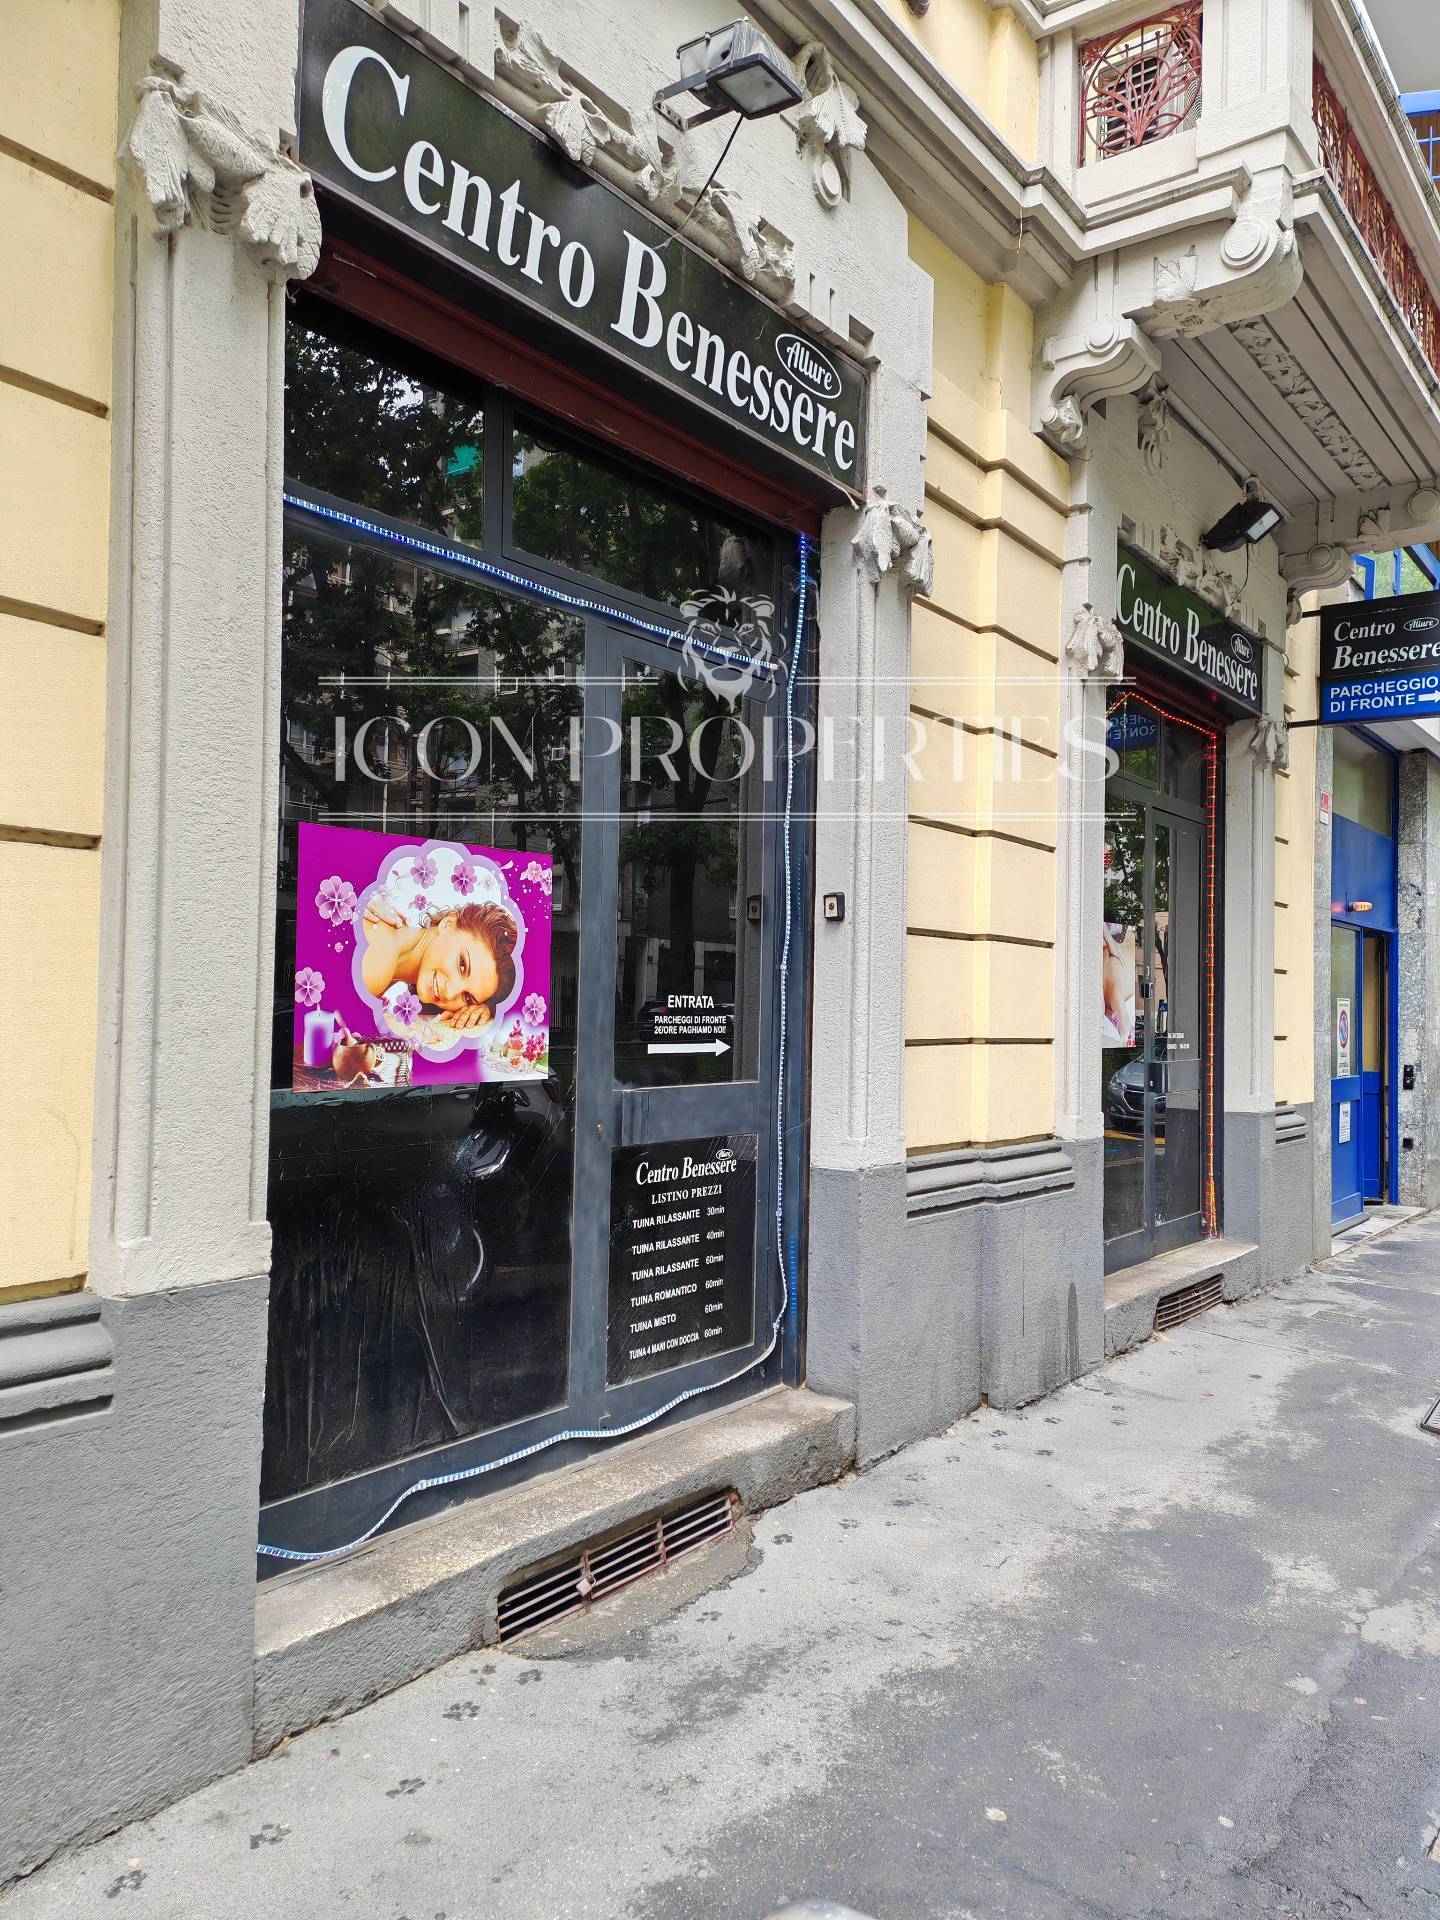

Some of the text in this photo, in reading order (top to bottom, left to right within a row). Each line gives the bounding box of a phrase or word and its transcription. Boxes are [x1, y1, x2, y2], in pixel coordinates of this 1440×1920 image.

[322, 46, 856, 471] Centro Benessere
[786, 341, 833, 391] Allure
[1117, 563, 1258, 701] Centro Benessere
[1334, 621, 1396, 642] Centro
[1332, 641, 1440, 670] Benessere
[1330, 676, 1439, 699] PARCHEGGIO
[1330, 693, 1416, 713] DI FRONTE
[667, 995, 715, 1009] ENTRATA
[654, 1016, 727, 1024] PARCHEGGI DI FRONTE
[678, 1025, 713, 1034] PAGHIAMO
[636, 1156, 737, 1185] Centro Benessere
[651, 1184, 723, 1205] LISTINO PREZZI
[632, 1205, 725, 1229] TUINA RILASSANTE 30min
[631, 1229, 725, 1255] TUINA RILASSANTE 40min
[631, 1253, 724, 1282] TUINA RILASSANTE 60min
[630, 1278, 724, 1308] TUINA ROMANTICO 60min
[630, 1301, 723, 1334] TUINA MISTO 60min
[629, 1346, 648, 1360] TUINA
[666, 1337, 679, 1350] CON
[679, 1332, 700, 1346] DOCCIA
[704, 1325, 723, 1338] 60min
